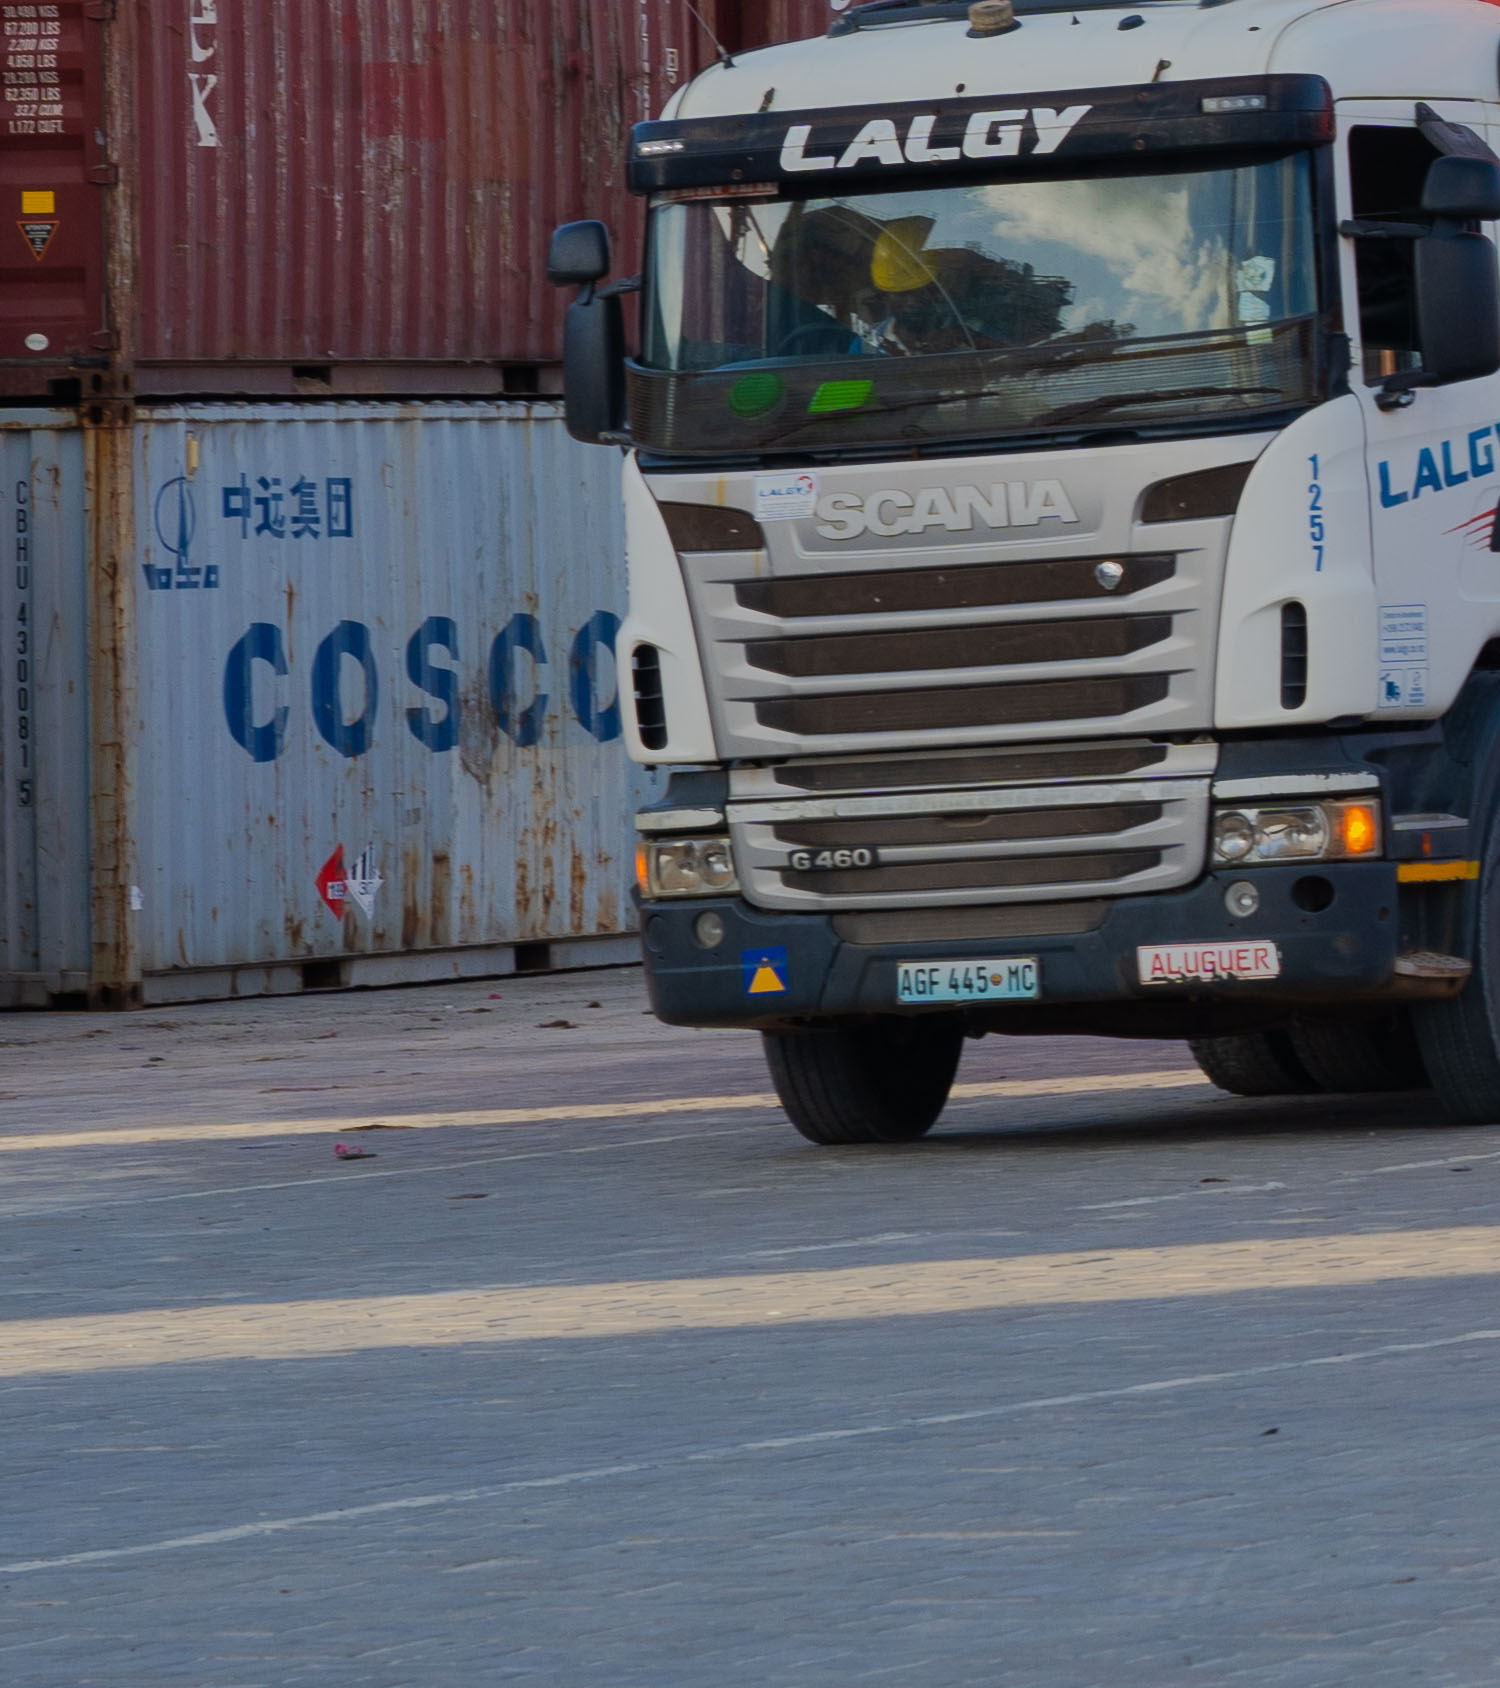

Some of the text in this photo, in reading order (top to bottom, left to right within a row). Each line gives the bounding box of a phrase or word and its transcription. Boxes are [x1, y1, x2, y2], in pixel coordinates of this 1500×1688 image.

[39, 5, 60, 18] KGS
[40, 21, 62, 35] LBS
[37, 54, 58, 68] LBS
[40, 87, 62, 102] LBS
[779, 104, 1093, 172] LALGY
[222, 473, 355, 541] 中远集团
[815, 479, 1080, 541] SCANIA
[1307, 453, 1325, 572] 1257
[16, 480, 32, 807] CBHU 430081 5
[223, 610, 624, 763] COSCO
[792, 846, 872, 871] G 460
[901, 962, 1037, 997] AGF 445 MC
[1149, 945, 1272, 979] ALUGUER
